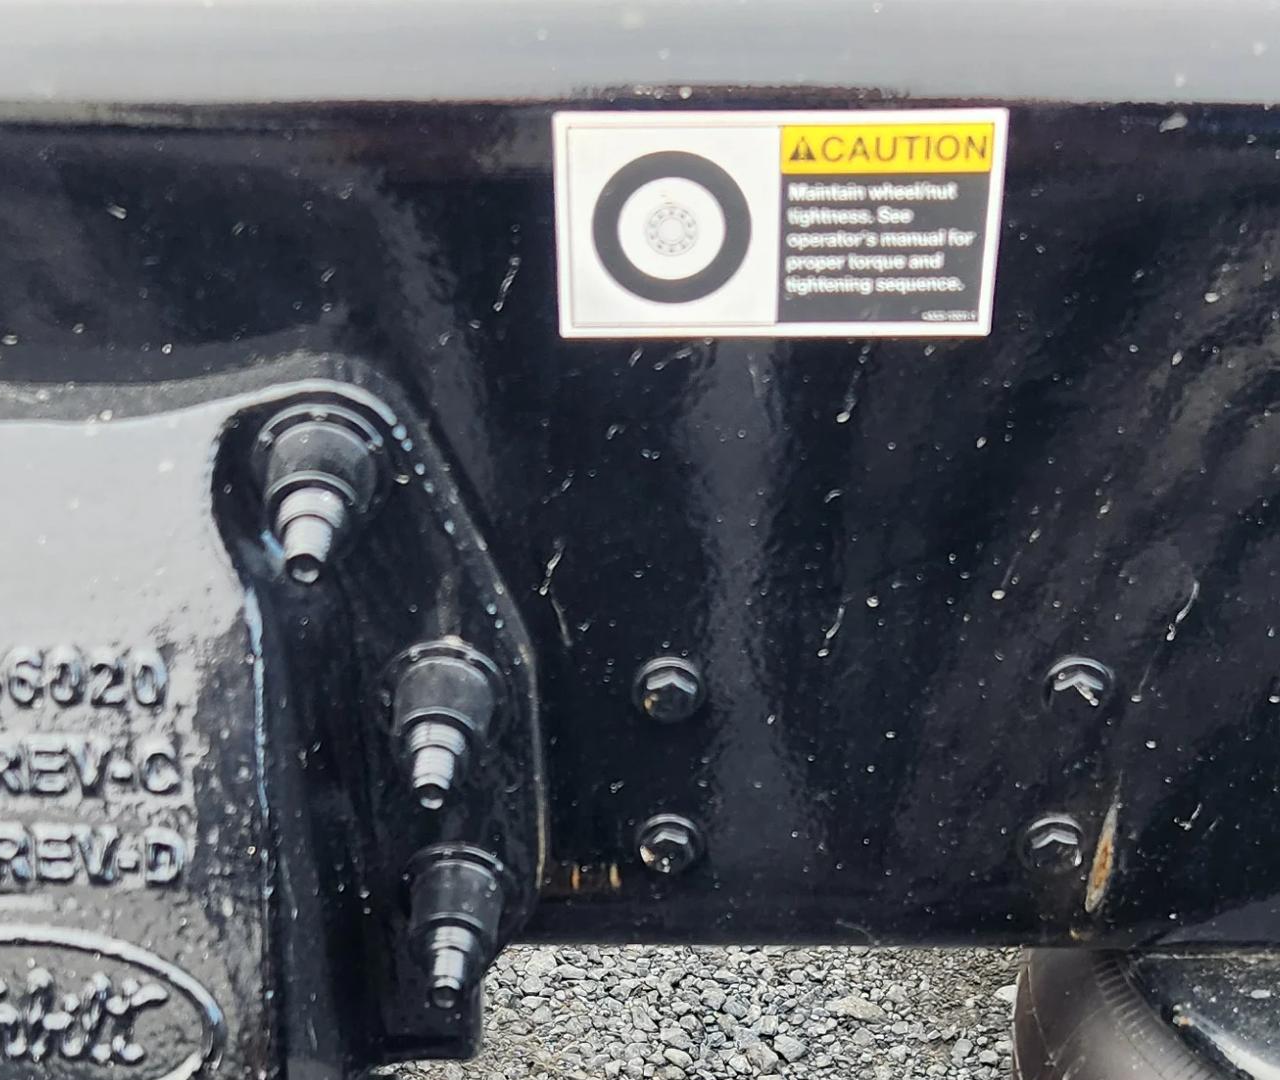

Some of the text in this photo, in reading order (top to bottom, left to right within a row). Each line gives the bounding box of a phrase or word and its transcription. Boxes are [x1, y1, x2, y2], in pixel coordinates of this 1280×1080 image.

[821, 135, 987, 161] CAUTION
[789, 182, 957, 200] Maintain wheel/nut
[787, 206, 913, 227] tightness. See
[787, 228, 976, 249] operator's manual for
[786, 252, 944, 272] proper torque and
[785, 275, 965, 295] tightening sequence.
